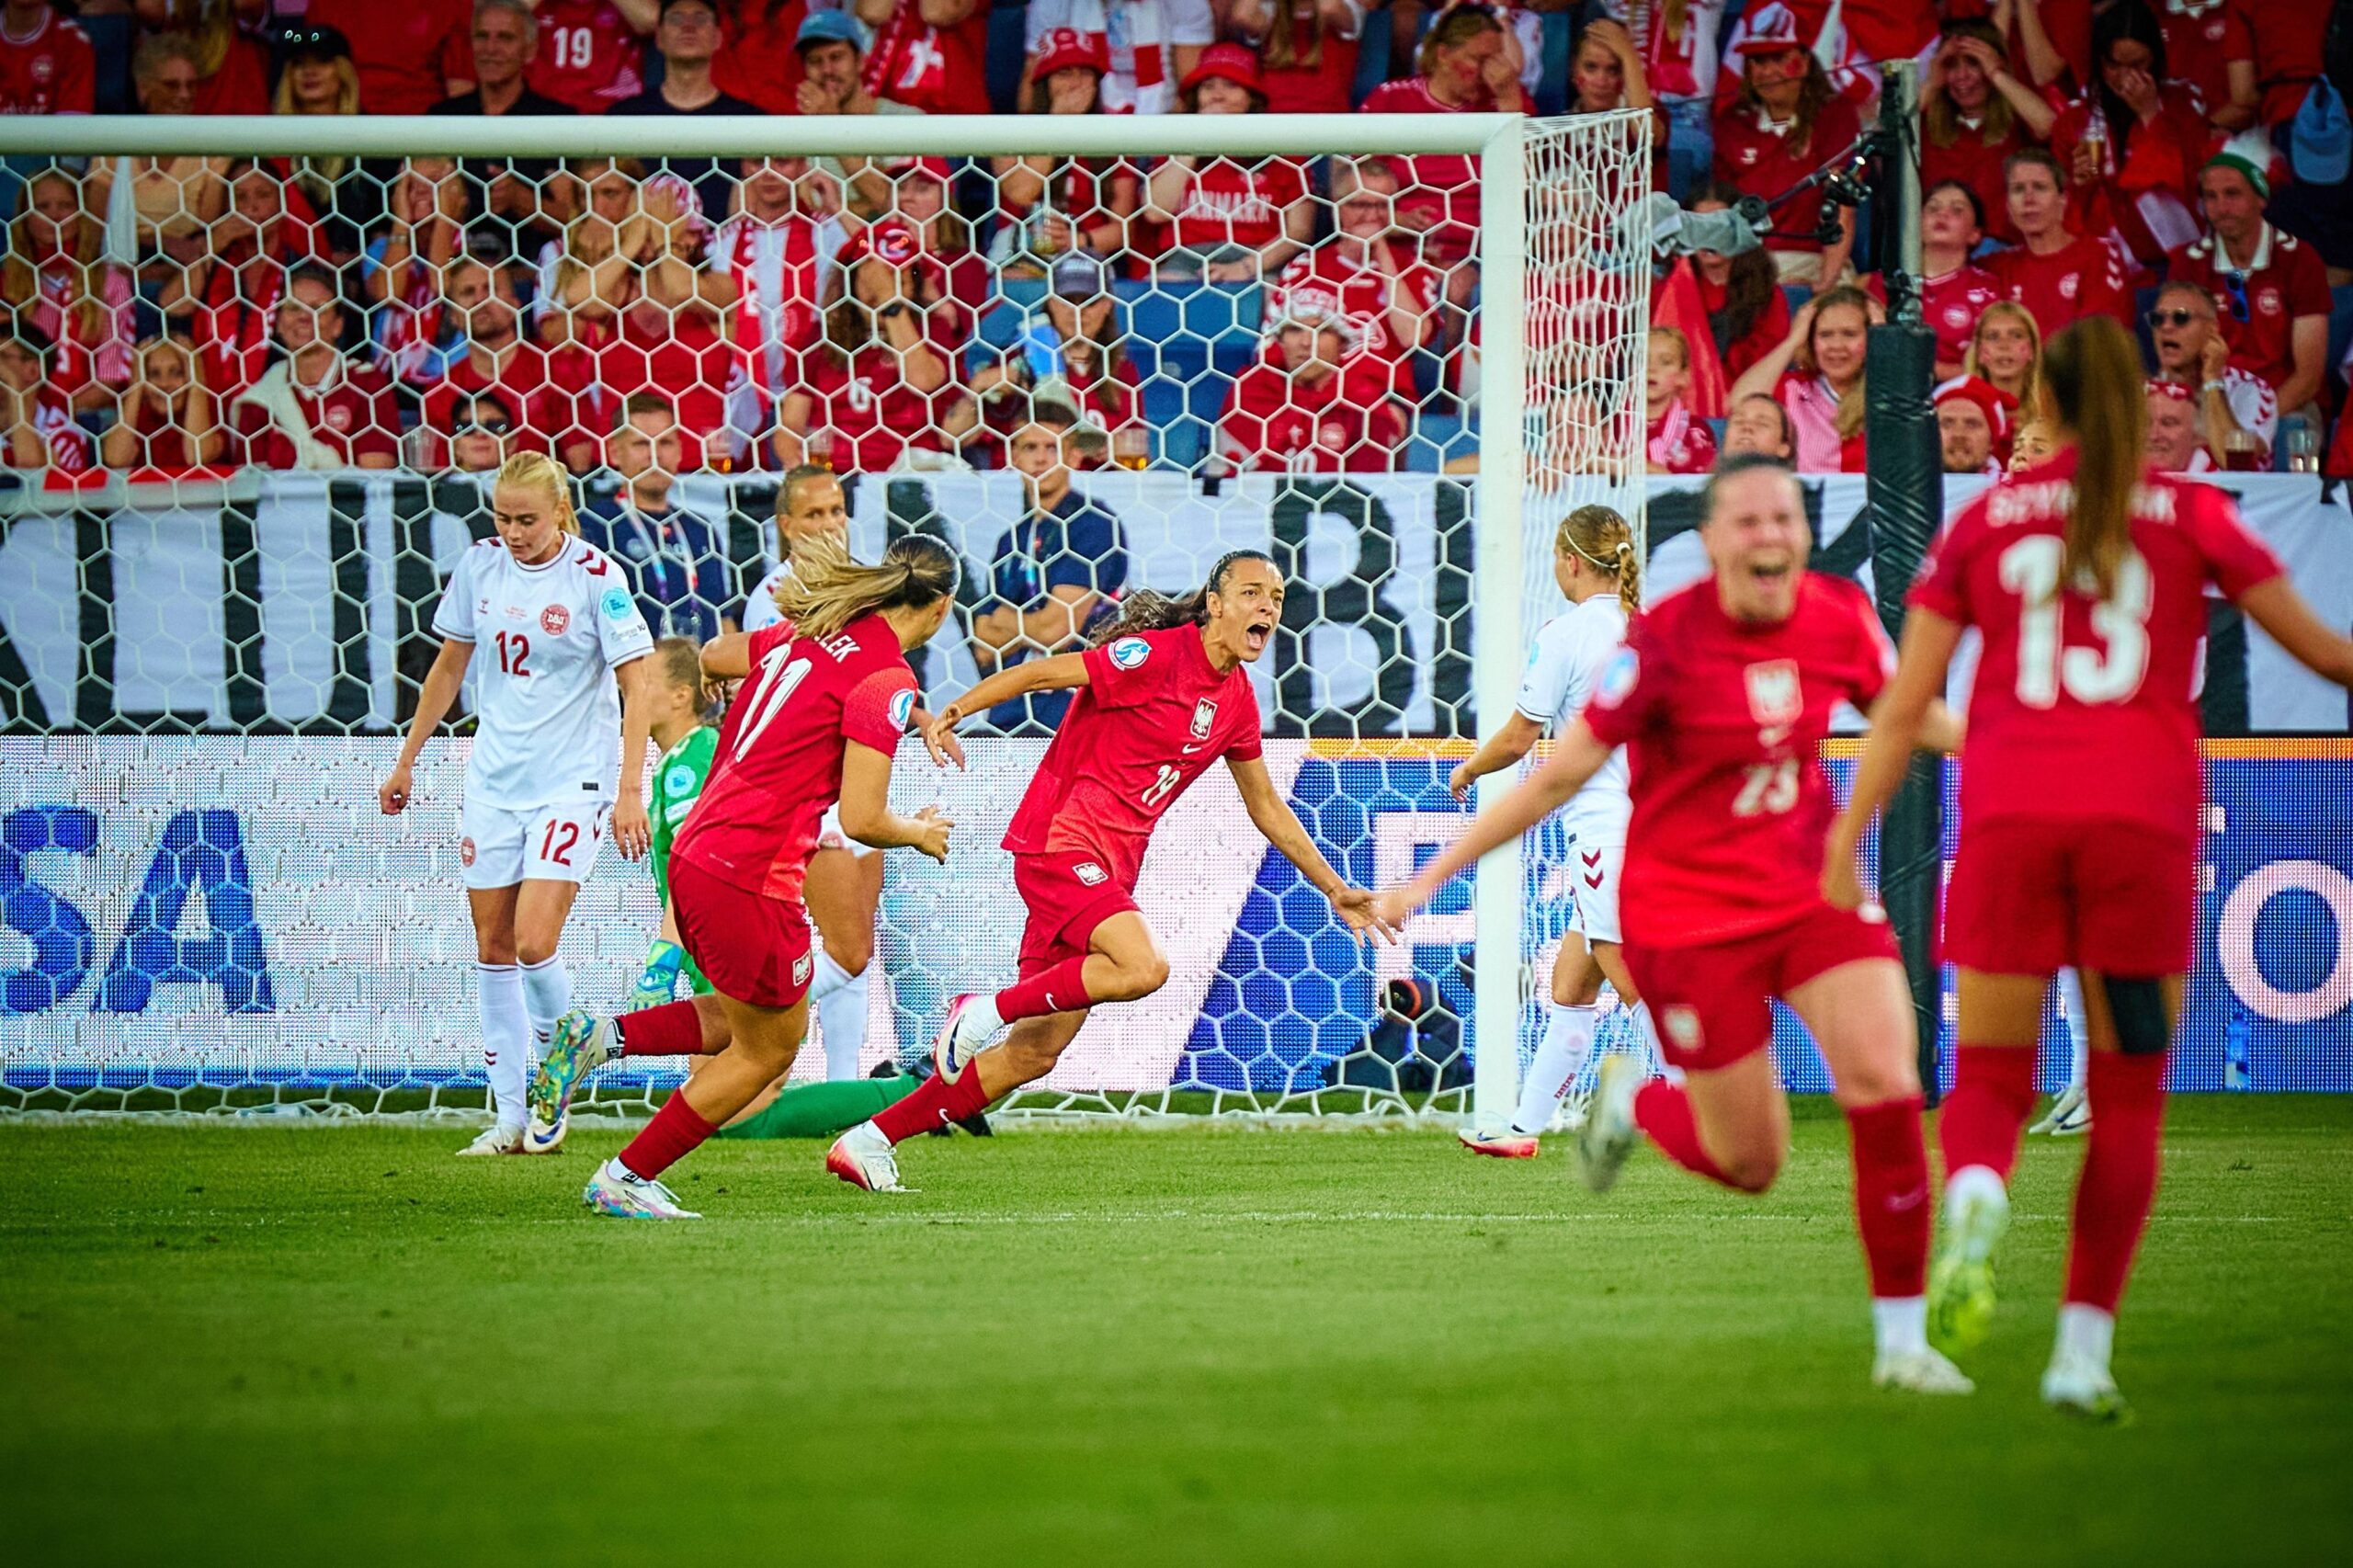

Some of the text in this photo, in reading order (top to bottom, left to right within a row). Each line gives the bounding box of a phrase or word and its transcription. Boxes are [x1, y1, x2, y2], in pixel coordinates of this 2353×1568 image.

[553, 26, 593, 69] 19
[1997, 533, 2154, 710] 13
[494, 630, 531, 677] 12
[813, 633, 861, 664] LEK
[732, 642, 813, 764] 11
[1141, 765, 1180, 807] 19
[1730, 757, 1800, 817] 23
[540, 818, 580, 867] 12
